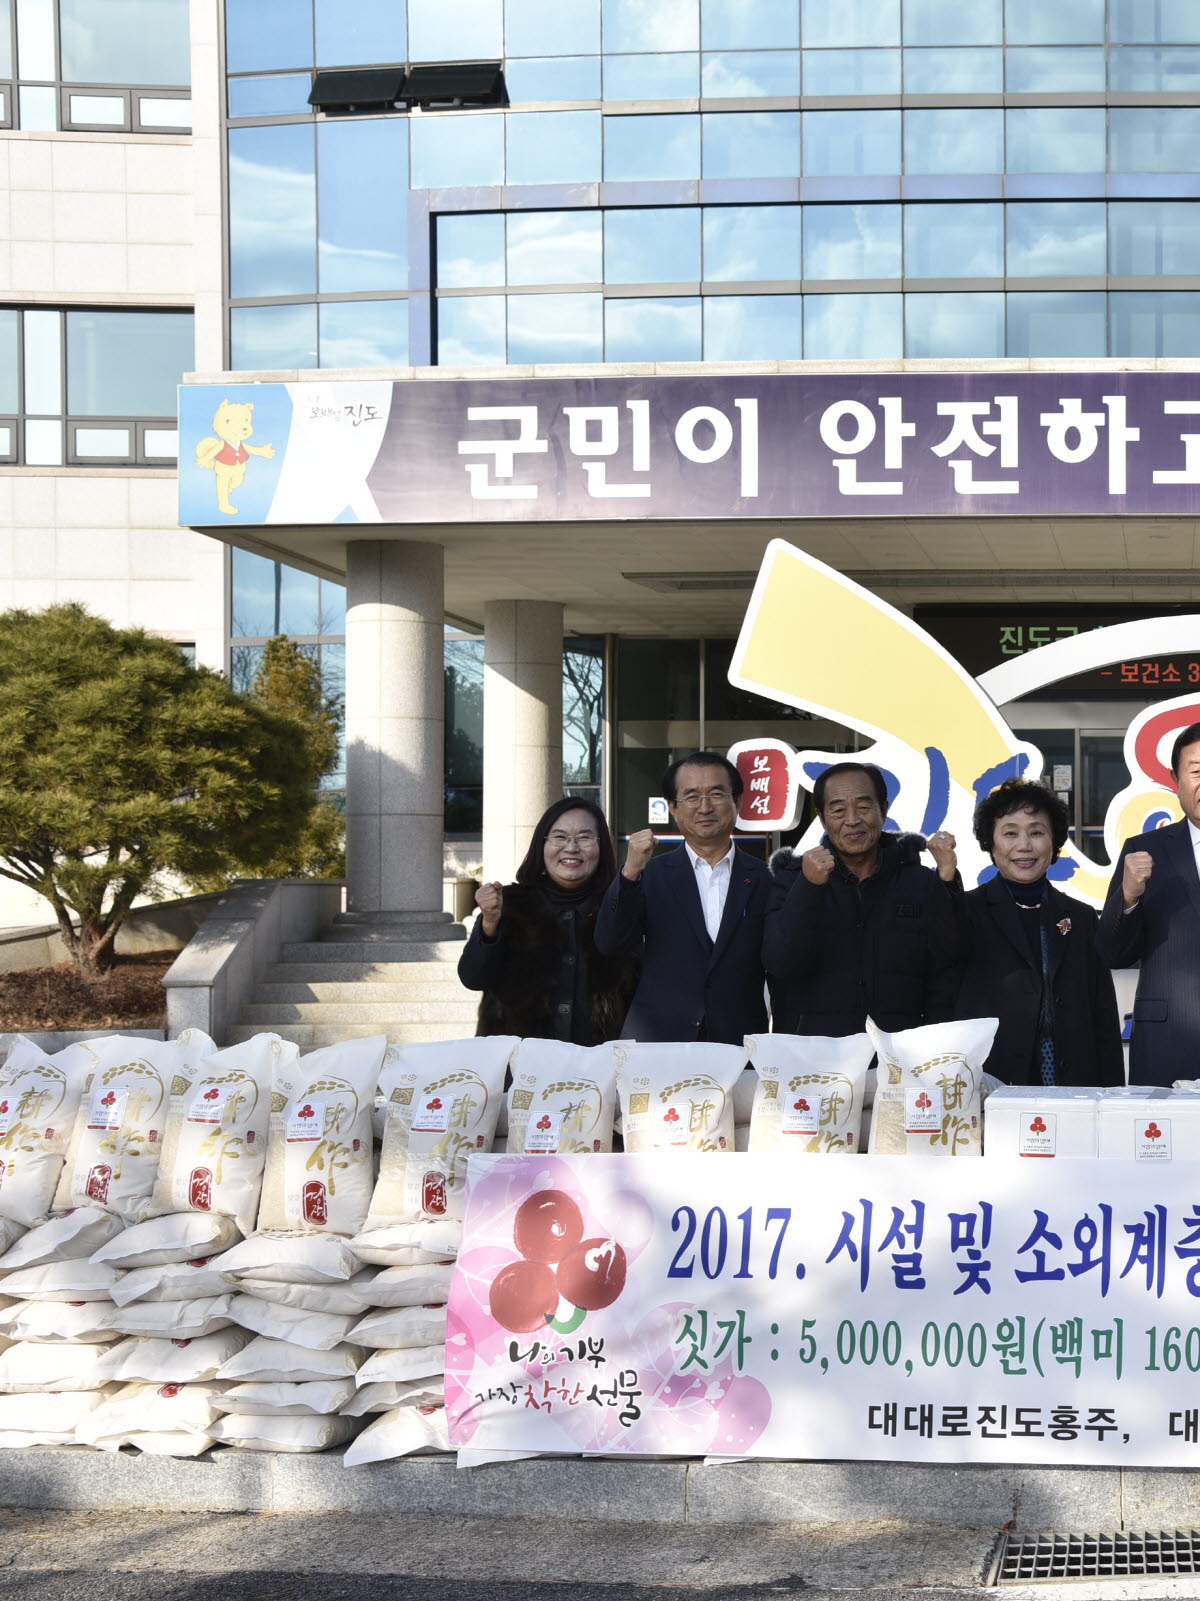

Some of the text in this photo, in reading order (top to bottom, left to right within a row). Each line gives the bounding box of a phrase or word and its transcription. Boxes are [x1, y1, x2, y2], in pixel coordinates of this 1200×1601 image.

[344, 403, 384, 427] 진도
[457, 397, 759, 500] 군민이
[1120, 663, 1182, 683] 보건소
[750, 755, 771, 815] 보배섬
[667, 1205, 806, 1280] 2017.
[825, 1198, 926, 1293] 시설
[947, 1200, 993, 1295] 및
[560, 1336, 606, 1368] 기부
[675, 1309, 752, 1372] 싯가
[799, 1315, 1123, 1380] 5,000,000원(백미
[475, 1369, 643, 1428] 가장 착한 선물
[868, 1402, 1131, 1444] 대대로진도홍주,
